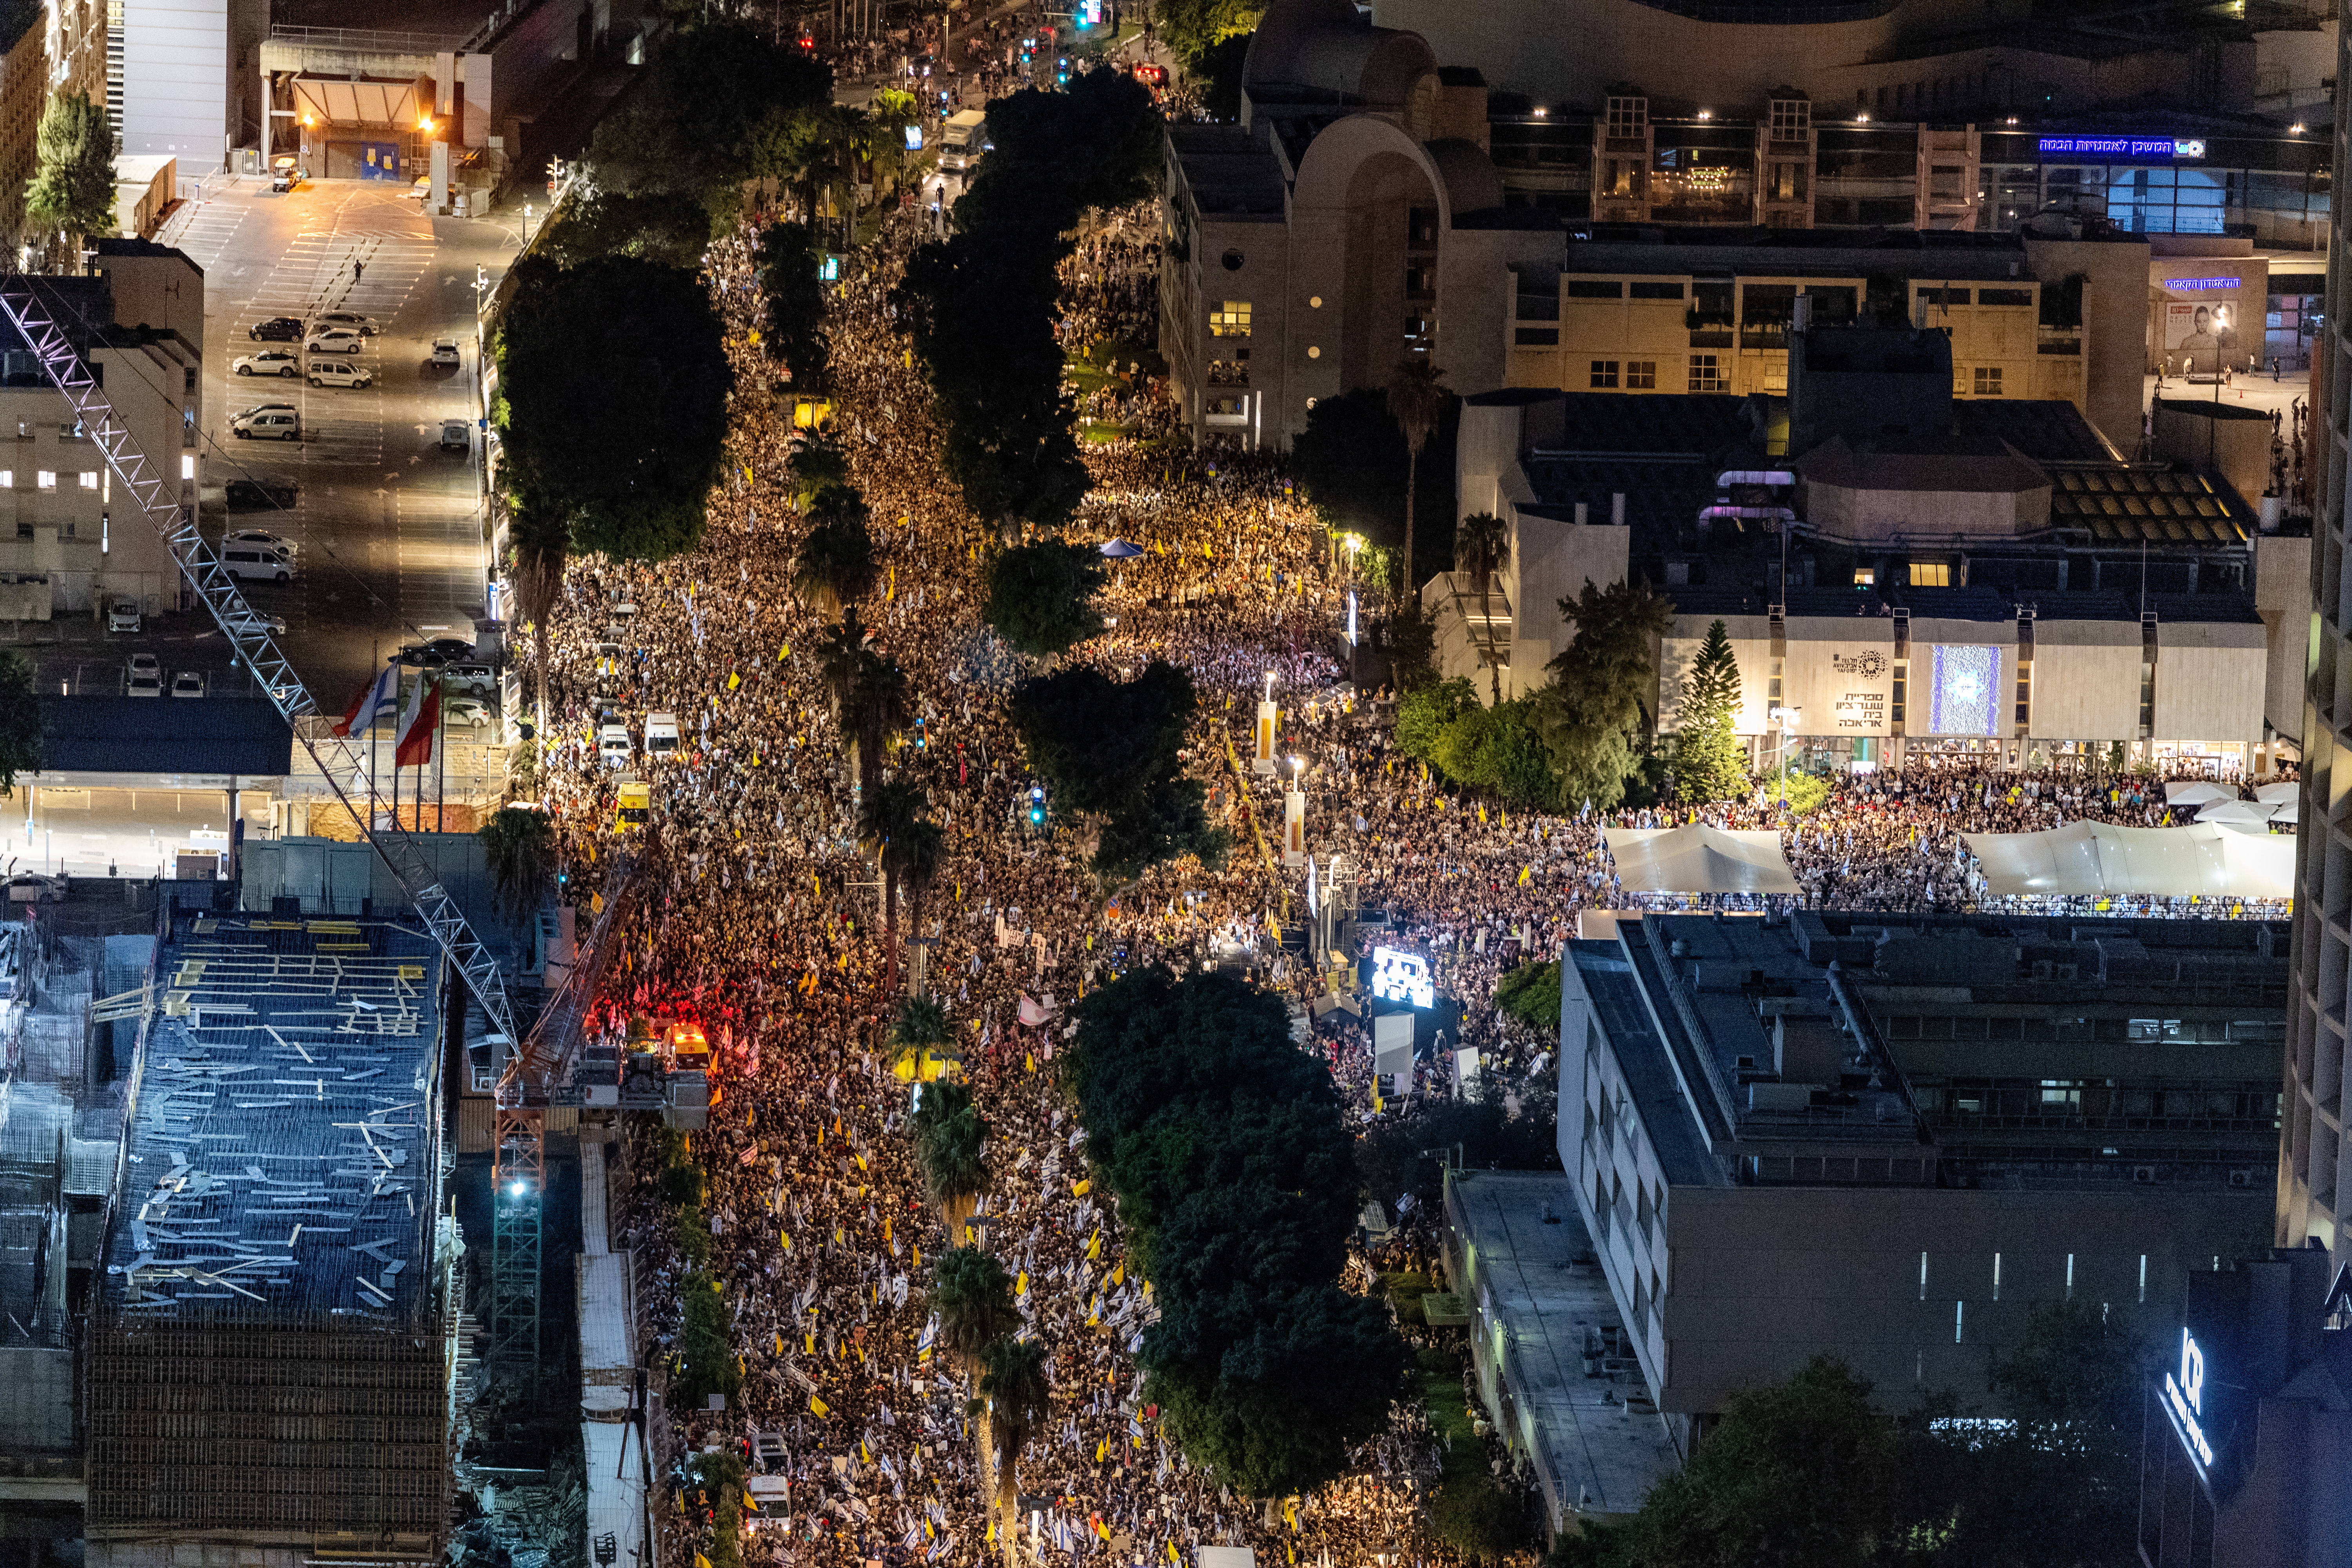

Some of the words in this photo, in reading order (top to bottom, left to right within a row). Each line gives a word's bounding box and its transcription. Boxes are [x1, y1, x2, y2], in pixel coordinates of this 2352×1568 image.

[2040, 140, 2073, 151] הבמה
[2076, 140, 2128, 152] לאמנויות
[2132, 141, 2172, 155] המשכן
[2164, 279, 2199, 291] הקאמרי
[2200, 277, 2241, 291] התיאטרון
